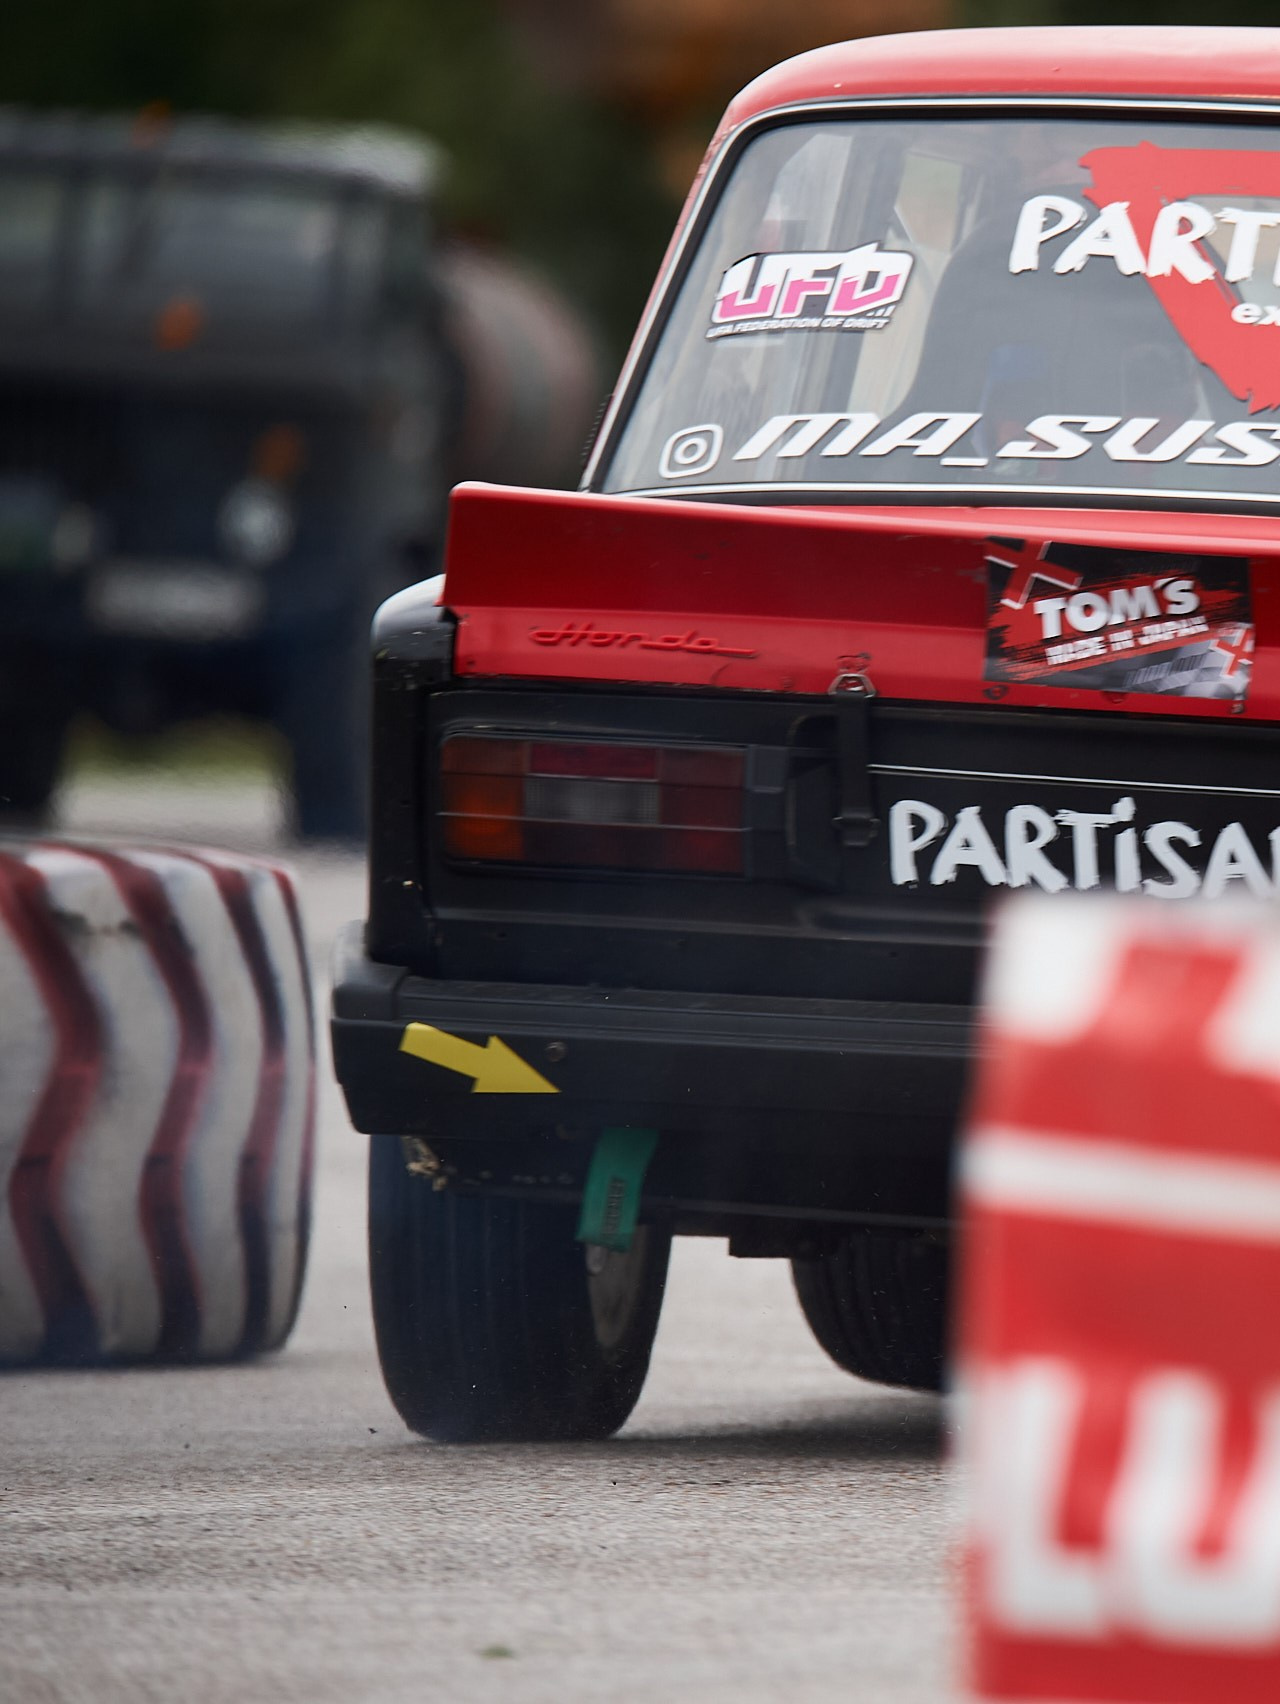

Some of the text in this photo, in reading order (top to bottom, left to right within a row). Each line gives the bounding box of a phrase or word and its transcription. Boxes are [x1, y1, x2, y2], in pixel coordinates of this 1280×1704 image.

[733, 317, 822, 333] FEDERATION
[821, 317, 844, 328] OF
[842, 318, 890, 329] DRIFT
[1033, 576, 1200, 639] TOM'S
